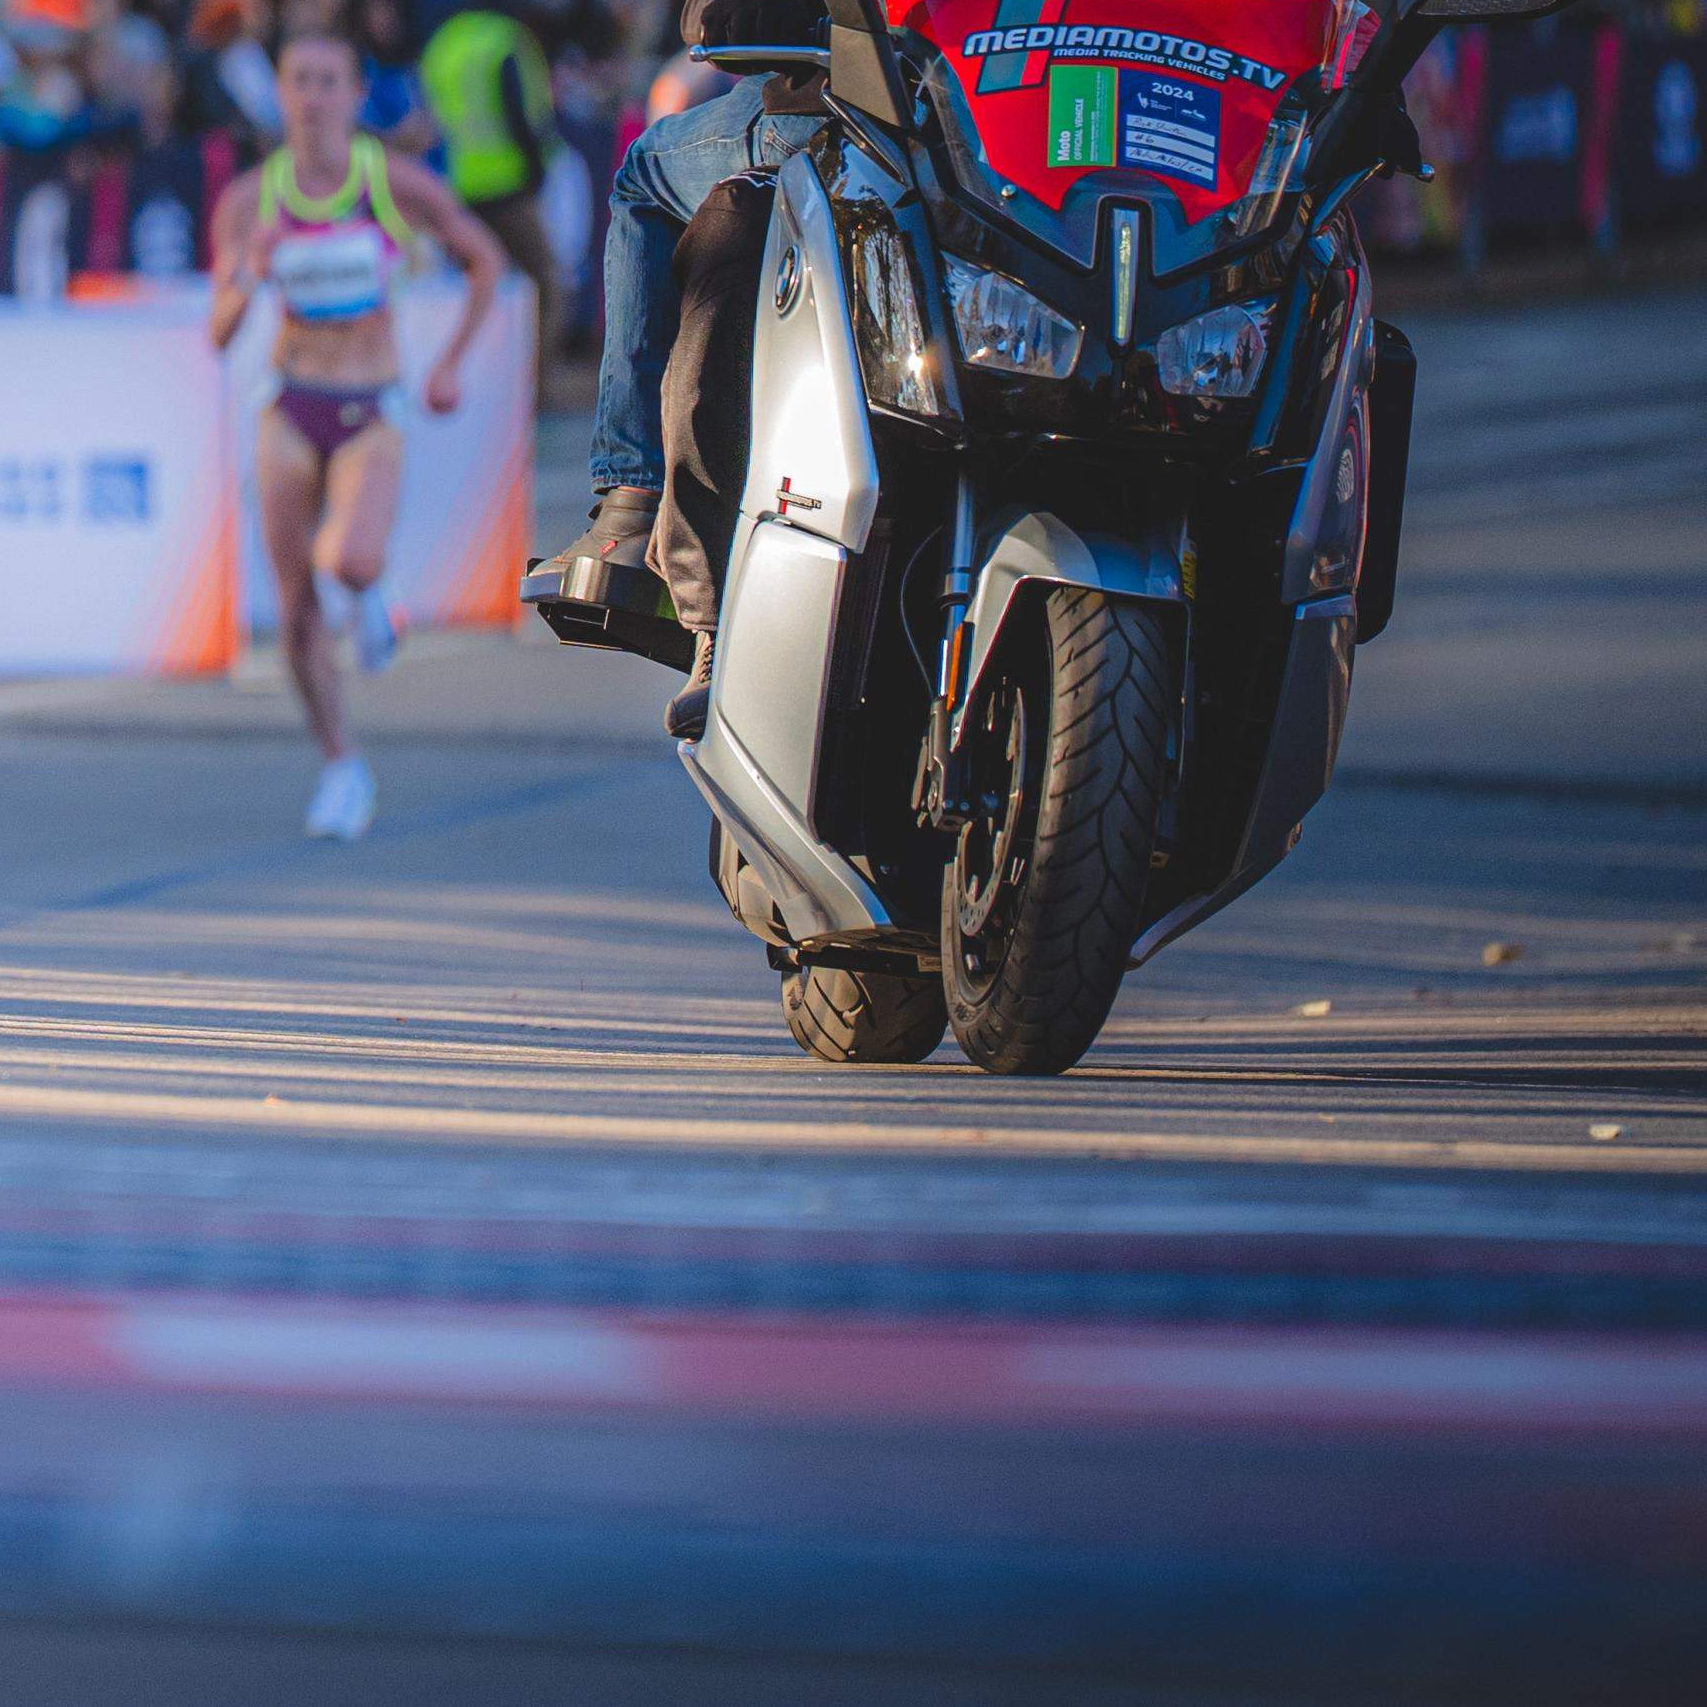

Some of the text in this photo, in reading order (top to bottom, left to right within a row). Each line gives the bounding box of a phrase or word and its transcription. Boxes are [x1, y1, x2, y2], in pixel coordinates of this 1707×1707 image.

[1053, 47, 1227, 82] MEDIA TRACKING VEHICLES
[1151, 81, 1195, 102] 2024
[1057, 130, 1071, 161] Moto
[1073, 98, 1084, 161] OFFICIAL VEHICLE
